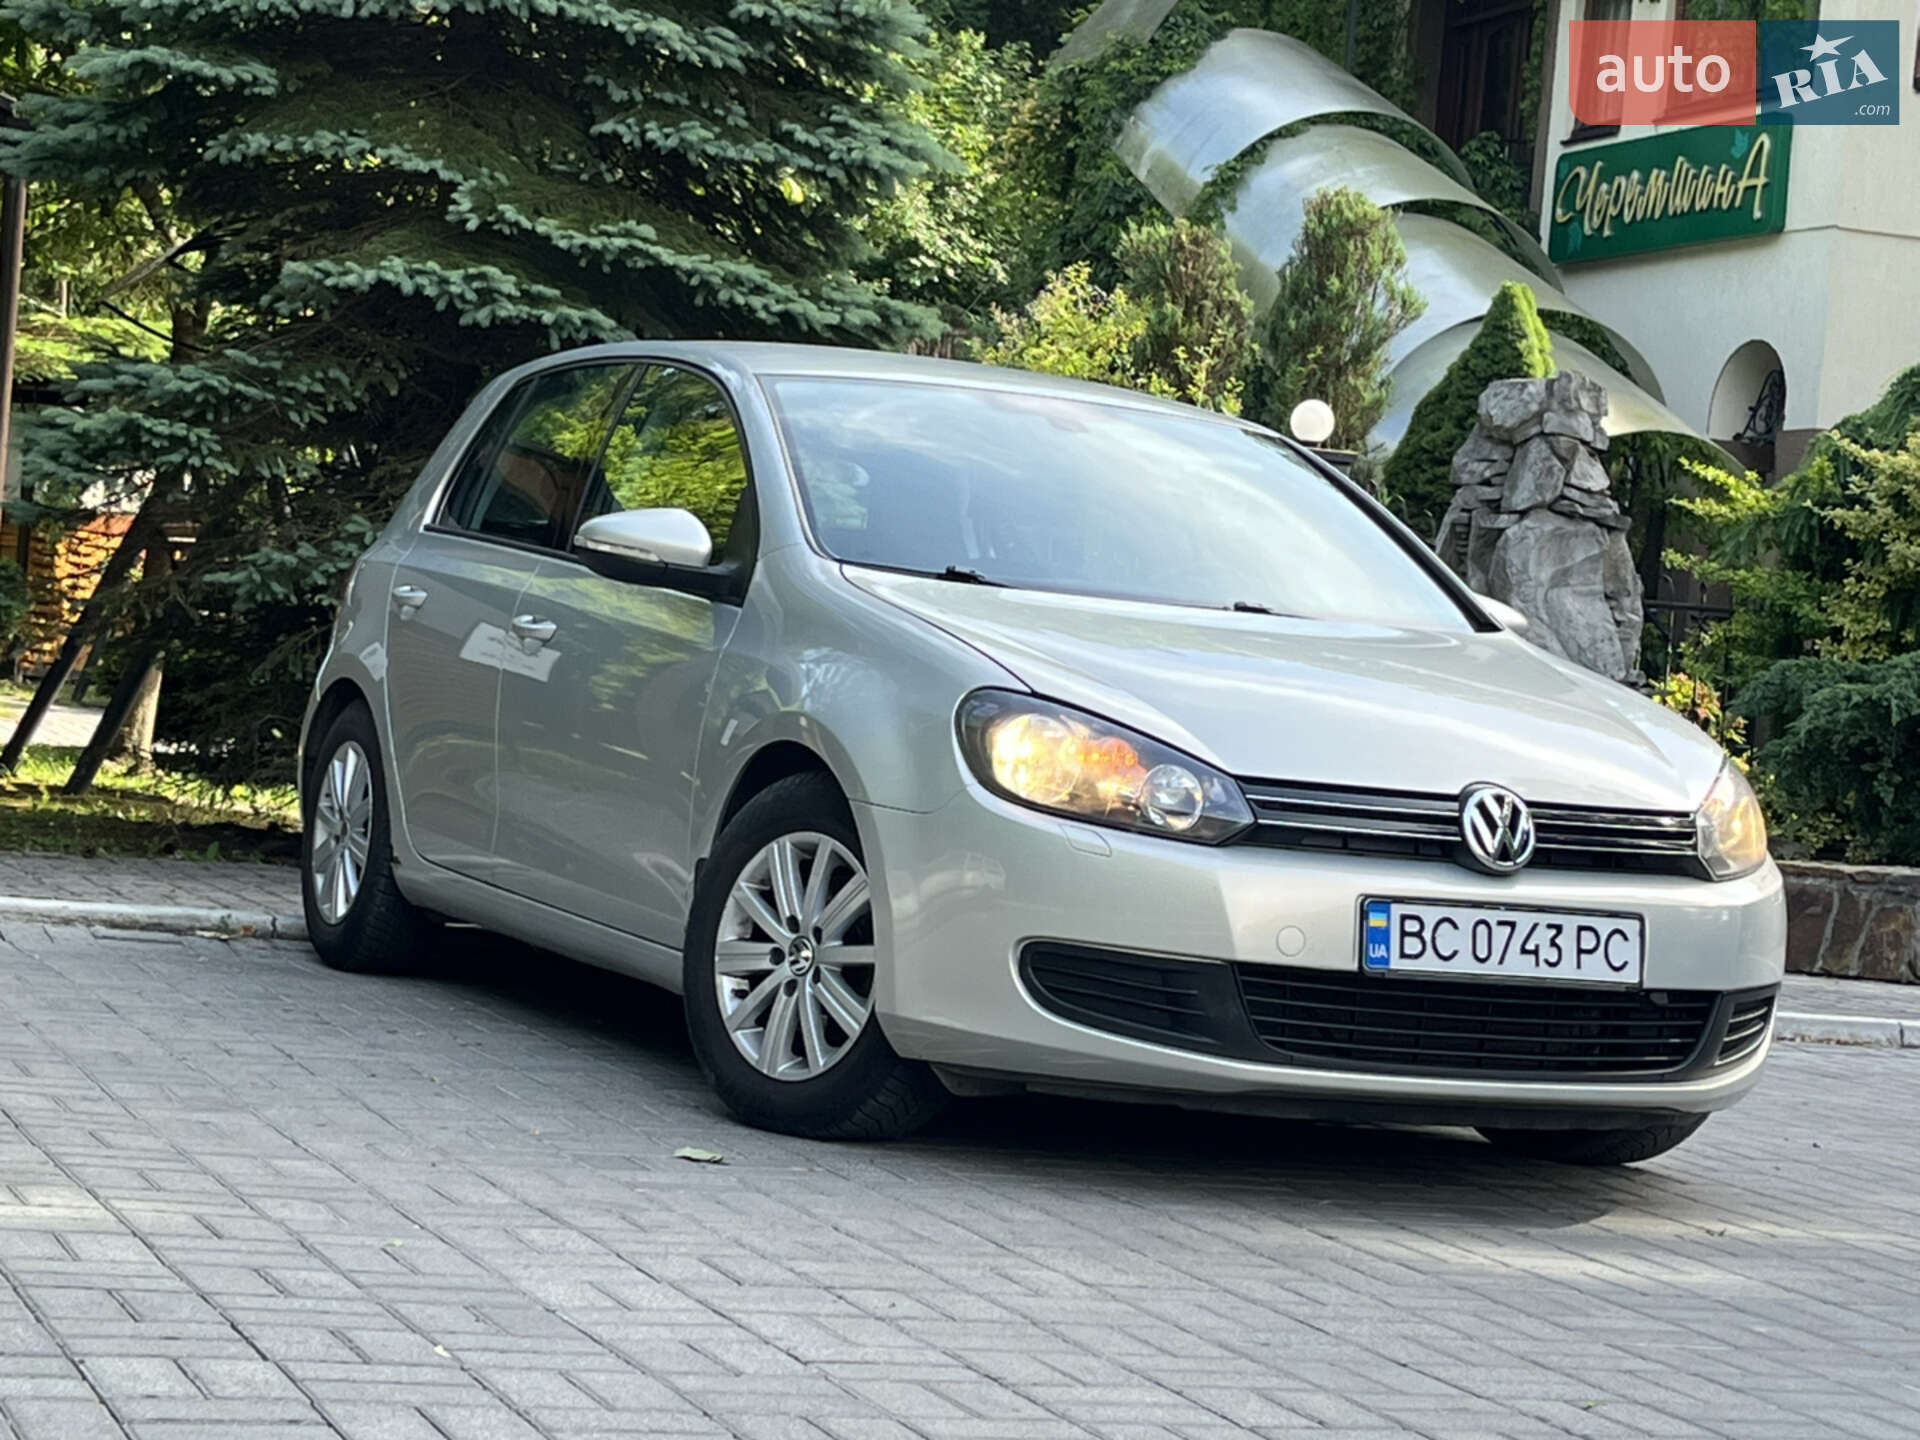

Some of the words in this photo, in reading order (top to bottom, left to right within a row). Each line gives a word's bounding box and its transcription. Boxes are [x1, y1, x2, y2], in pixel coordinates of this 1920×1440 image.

[1369, 943, 1388, 959] UA
[1398, 912, 1460, 962] BC
[1471, 918, 1564, 969] 0743
[1576, 924, 1630, 973] PC
